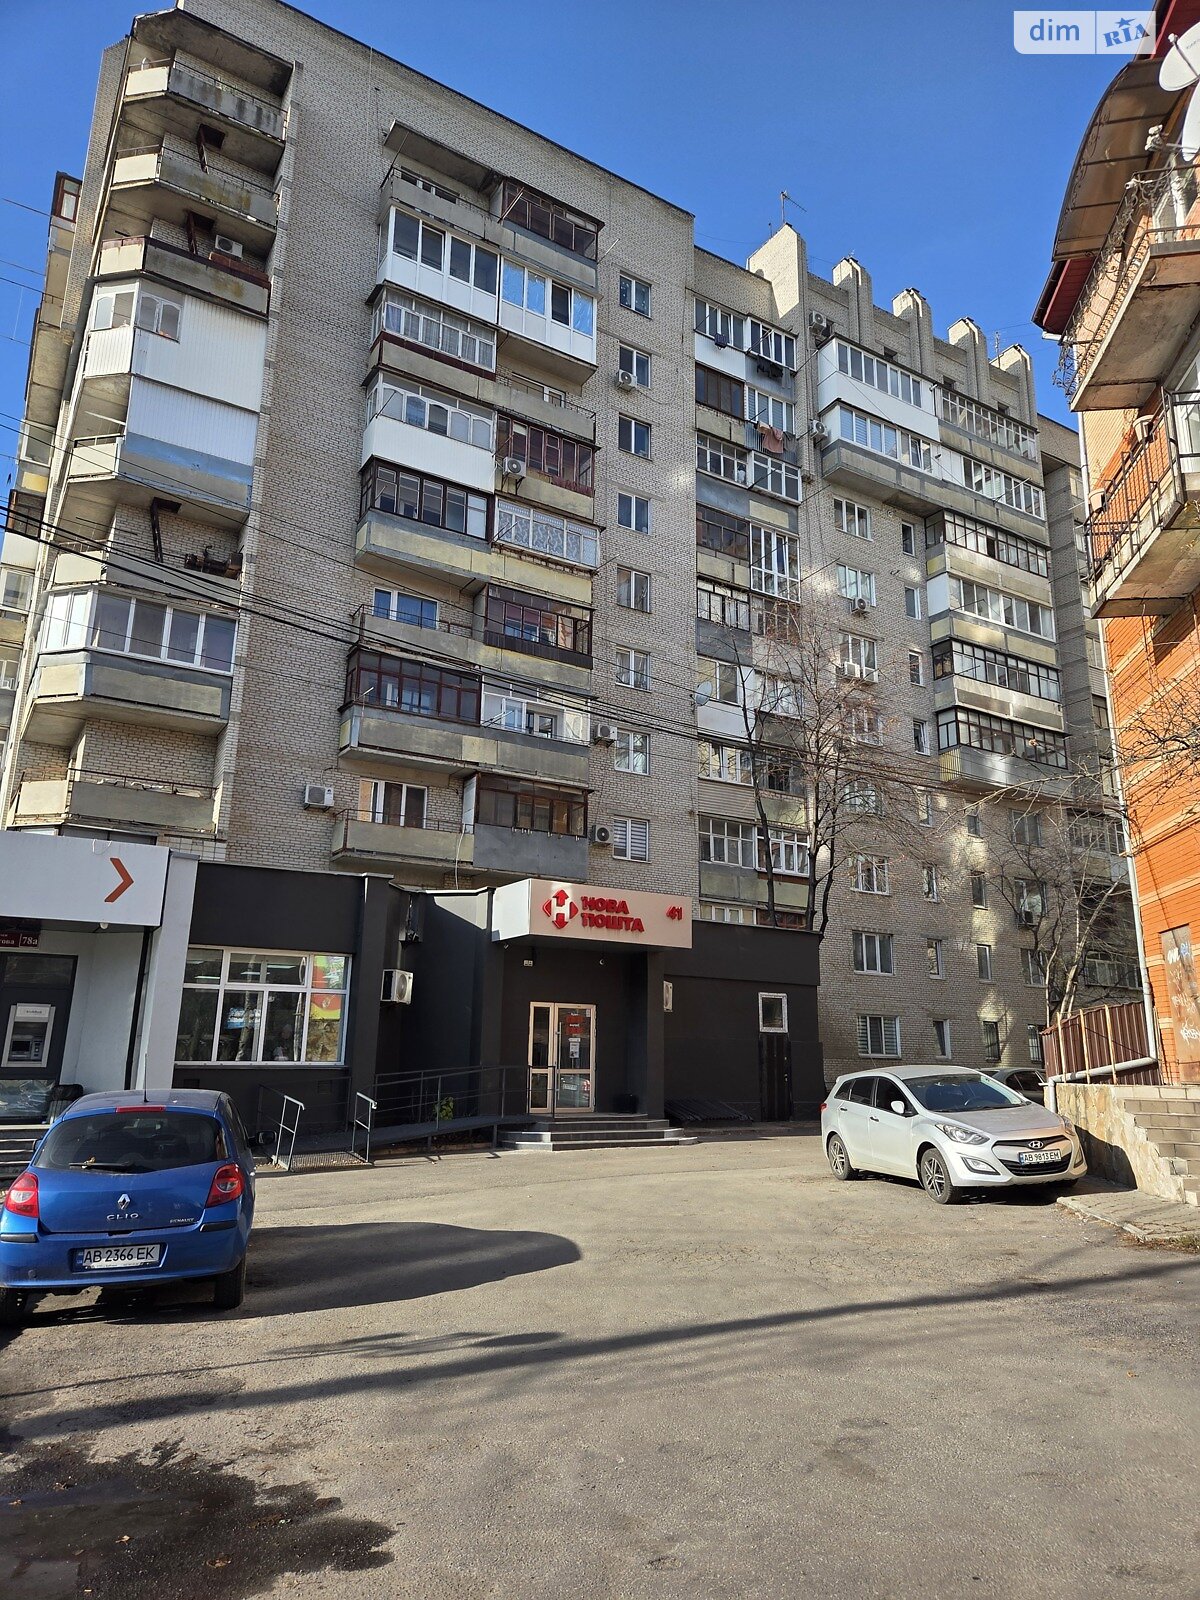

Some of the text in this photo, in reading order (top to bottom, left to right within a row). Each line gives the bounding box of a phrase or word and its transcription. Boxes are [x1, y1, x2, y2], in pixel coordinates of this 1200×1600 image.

[581, 896, 629, 914] НОВА
[666, 905, 683, 921] 41
[581, 912, 645, 933] ПОШТА
[106, 1212, 139, 1221] CLIO
[83, 1247, 155, 1263] AB 2366 EK
